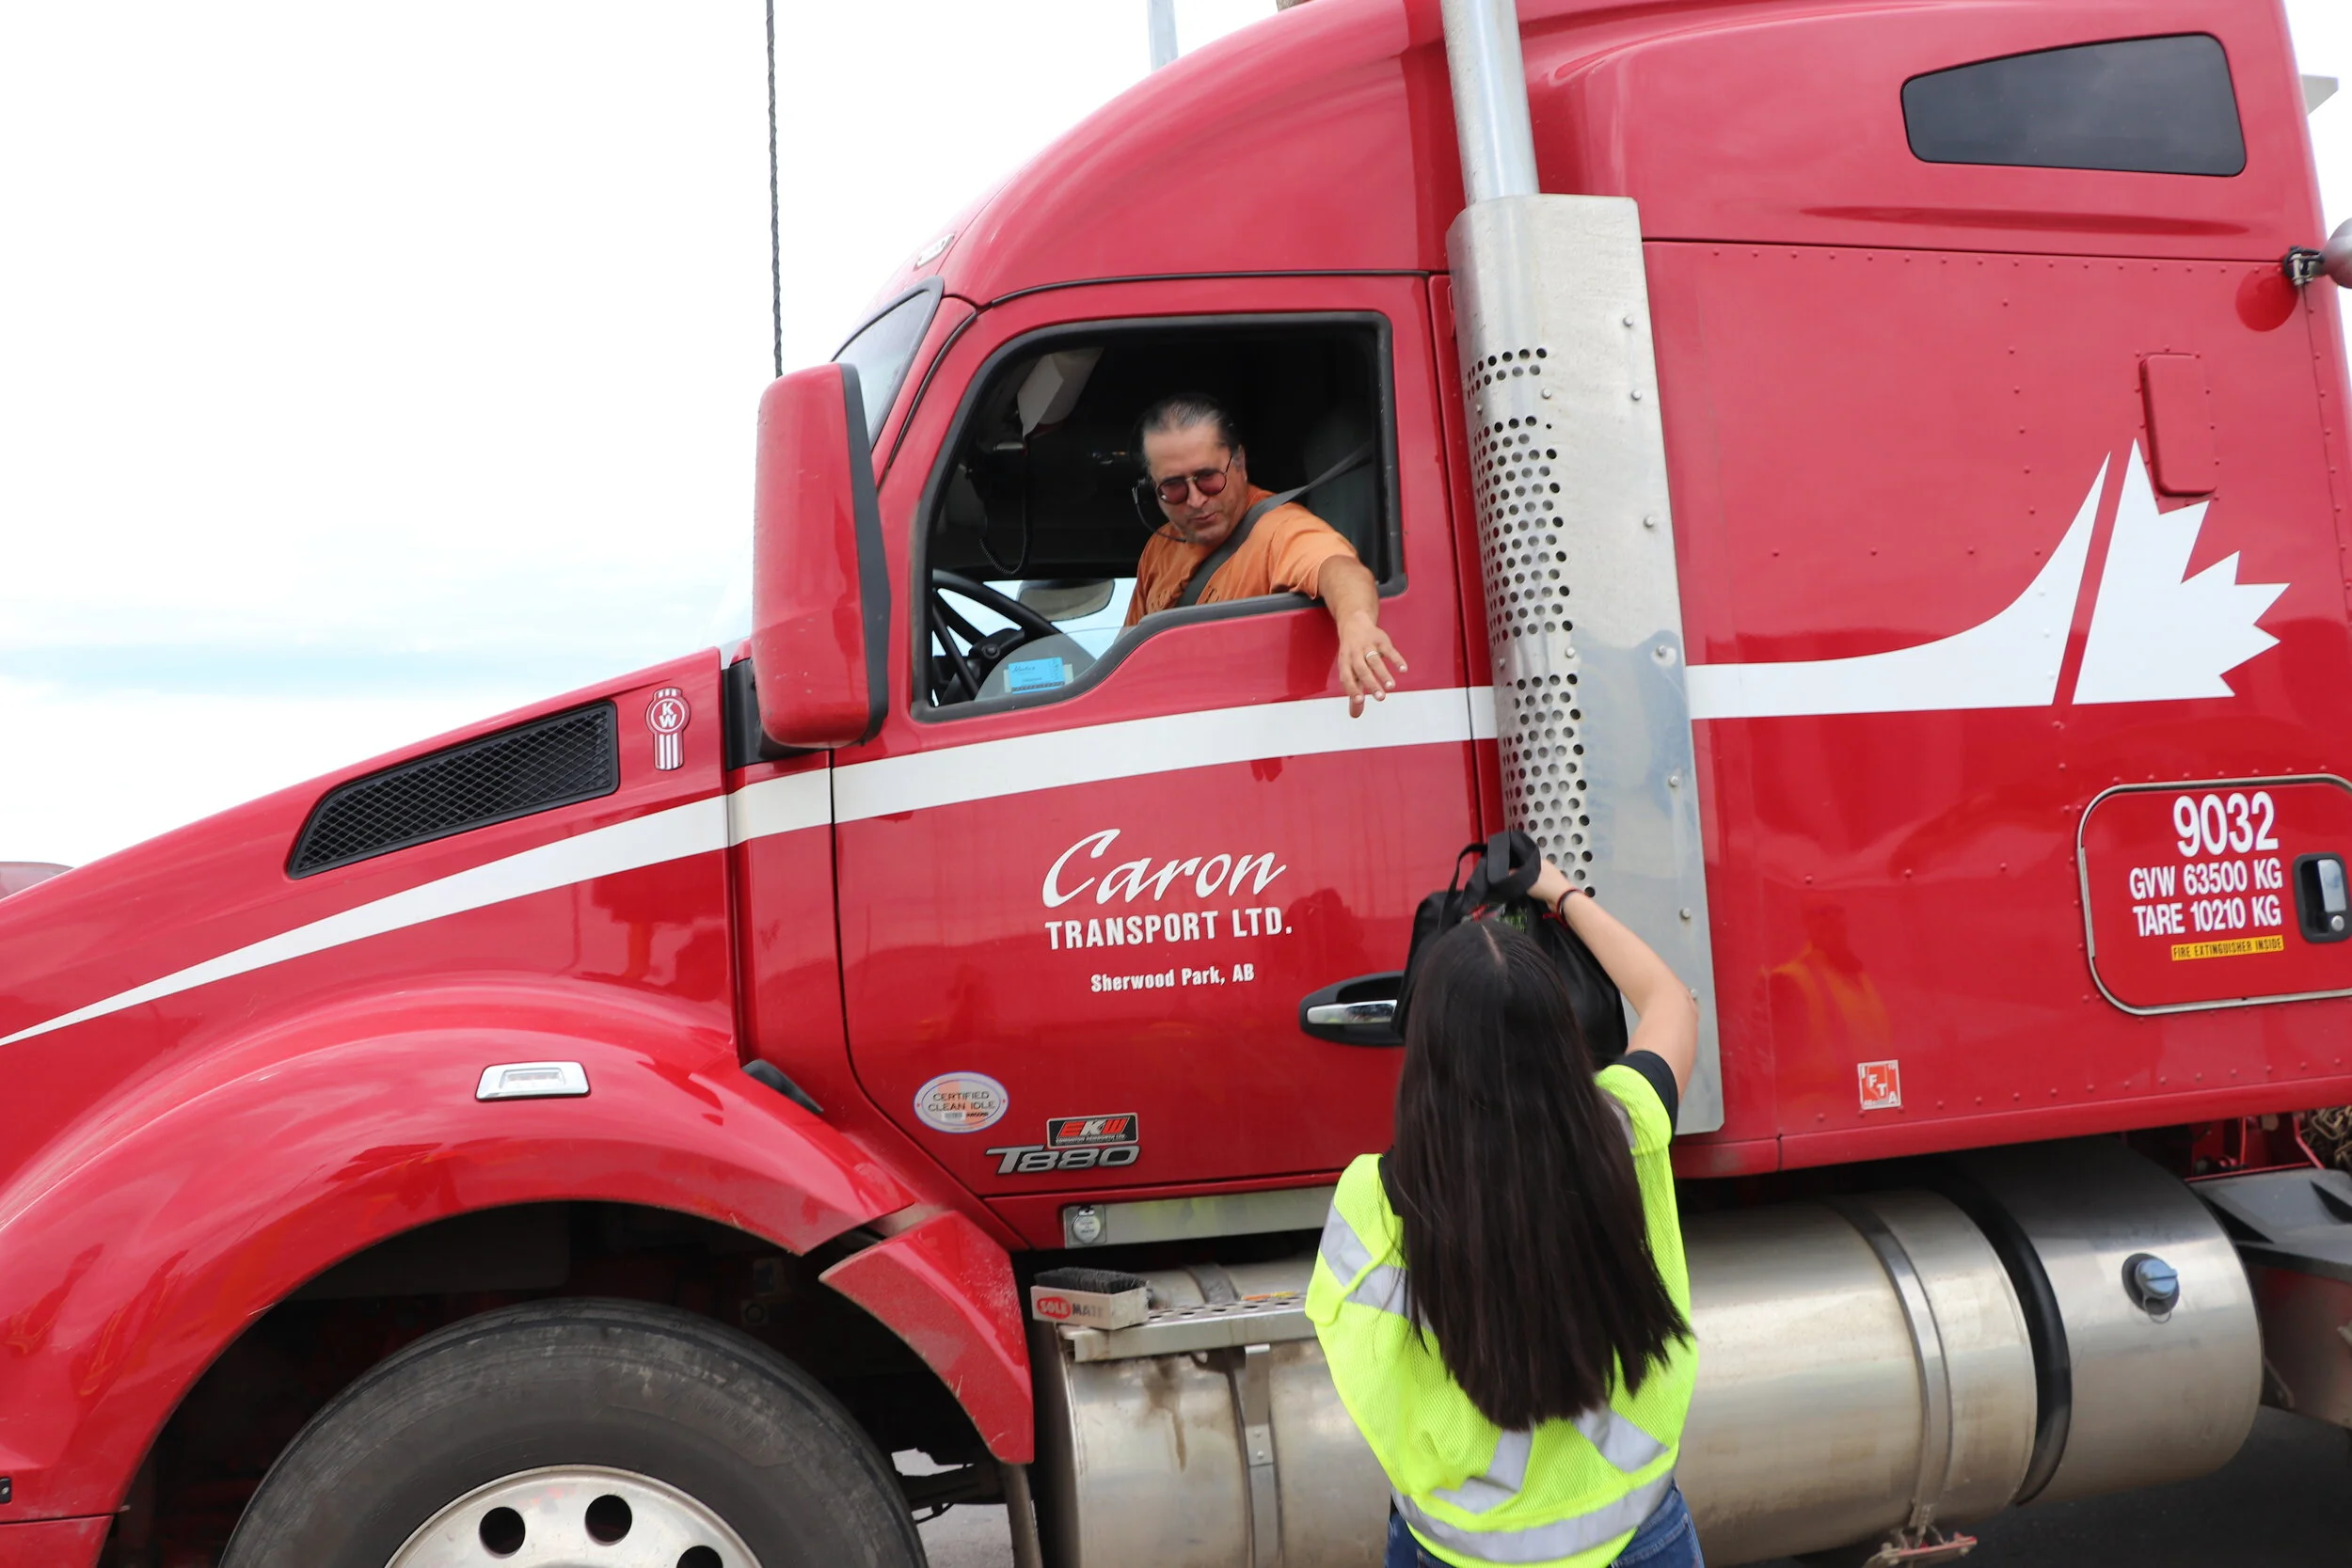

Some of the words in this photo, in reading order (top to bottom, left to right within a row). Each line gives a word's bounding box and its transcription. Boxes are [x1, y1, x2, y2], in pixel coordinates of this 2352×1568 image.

[2173, 791, 2279, 858] 9032
[1041, 828, 1287, 908] Caron
[2129, 865, 2175, 900] GVW
[2183, 860, 2248, 895] 63500
[2253, 857, 2282, 890] KG
[1044, 910, 1218, 950] TRANSPORT
[1232, 906, 1293, 938] LTD.
[2133, 902, 2185, 937] TARE
[2190, 896, 2246, 932] 10210
[2252, 894, 2281, 927] KG
[2173, 945, 2190, 958] FIRE
[2194, 941, 2252, 956] EXTINGUISHER
[2255, 937, 2281, 951] INSIDE
[1090, 969, 1175, 993] Sherwood
[1181, 965, 1225, 987] Park,
[1232, 962, 1255, 983] AB
[928, 1102, 966, 1112] CLEAN
[971, 1101, 995, 1110] IDLE
[932, 1090, 990, 1101] CERTIFIED
[985, 1144, 1141, 1175] T880
